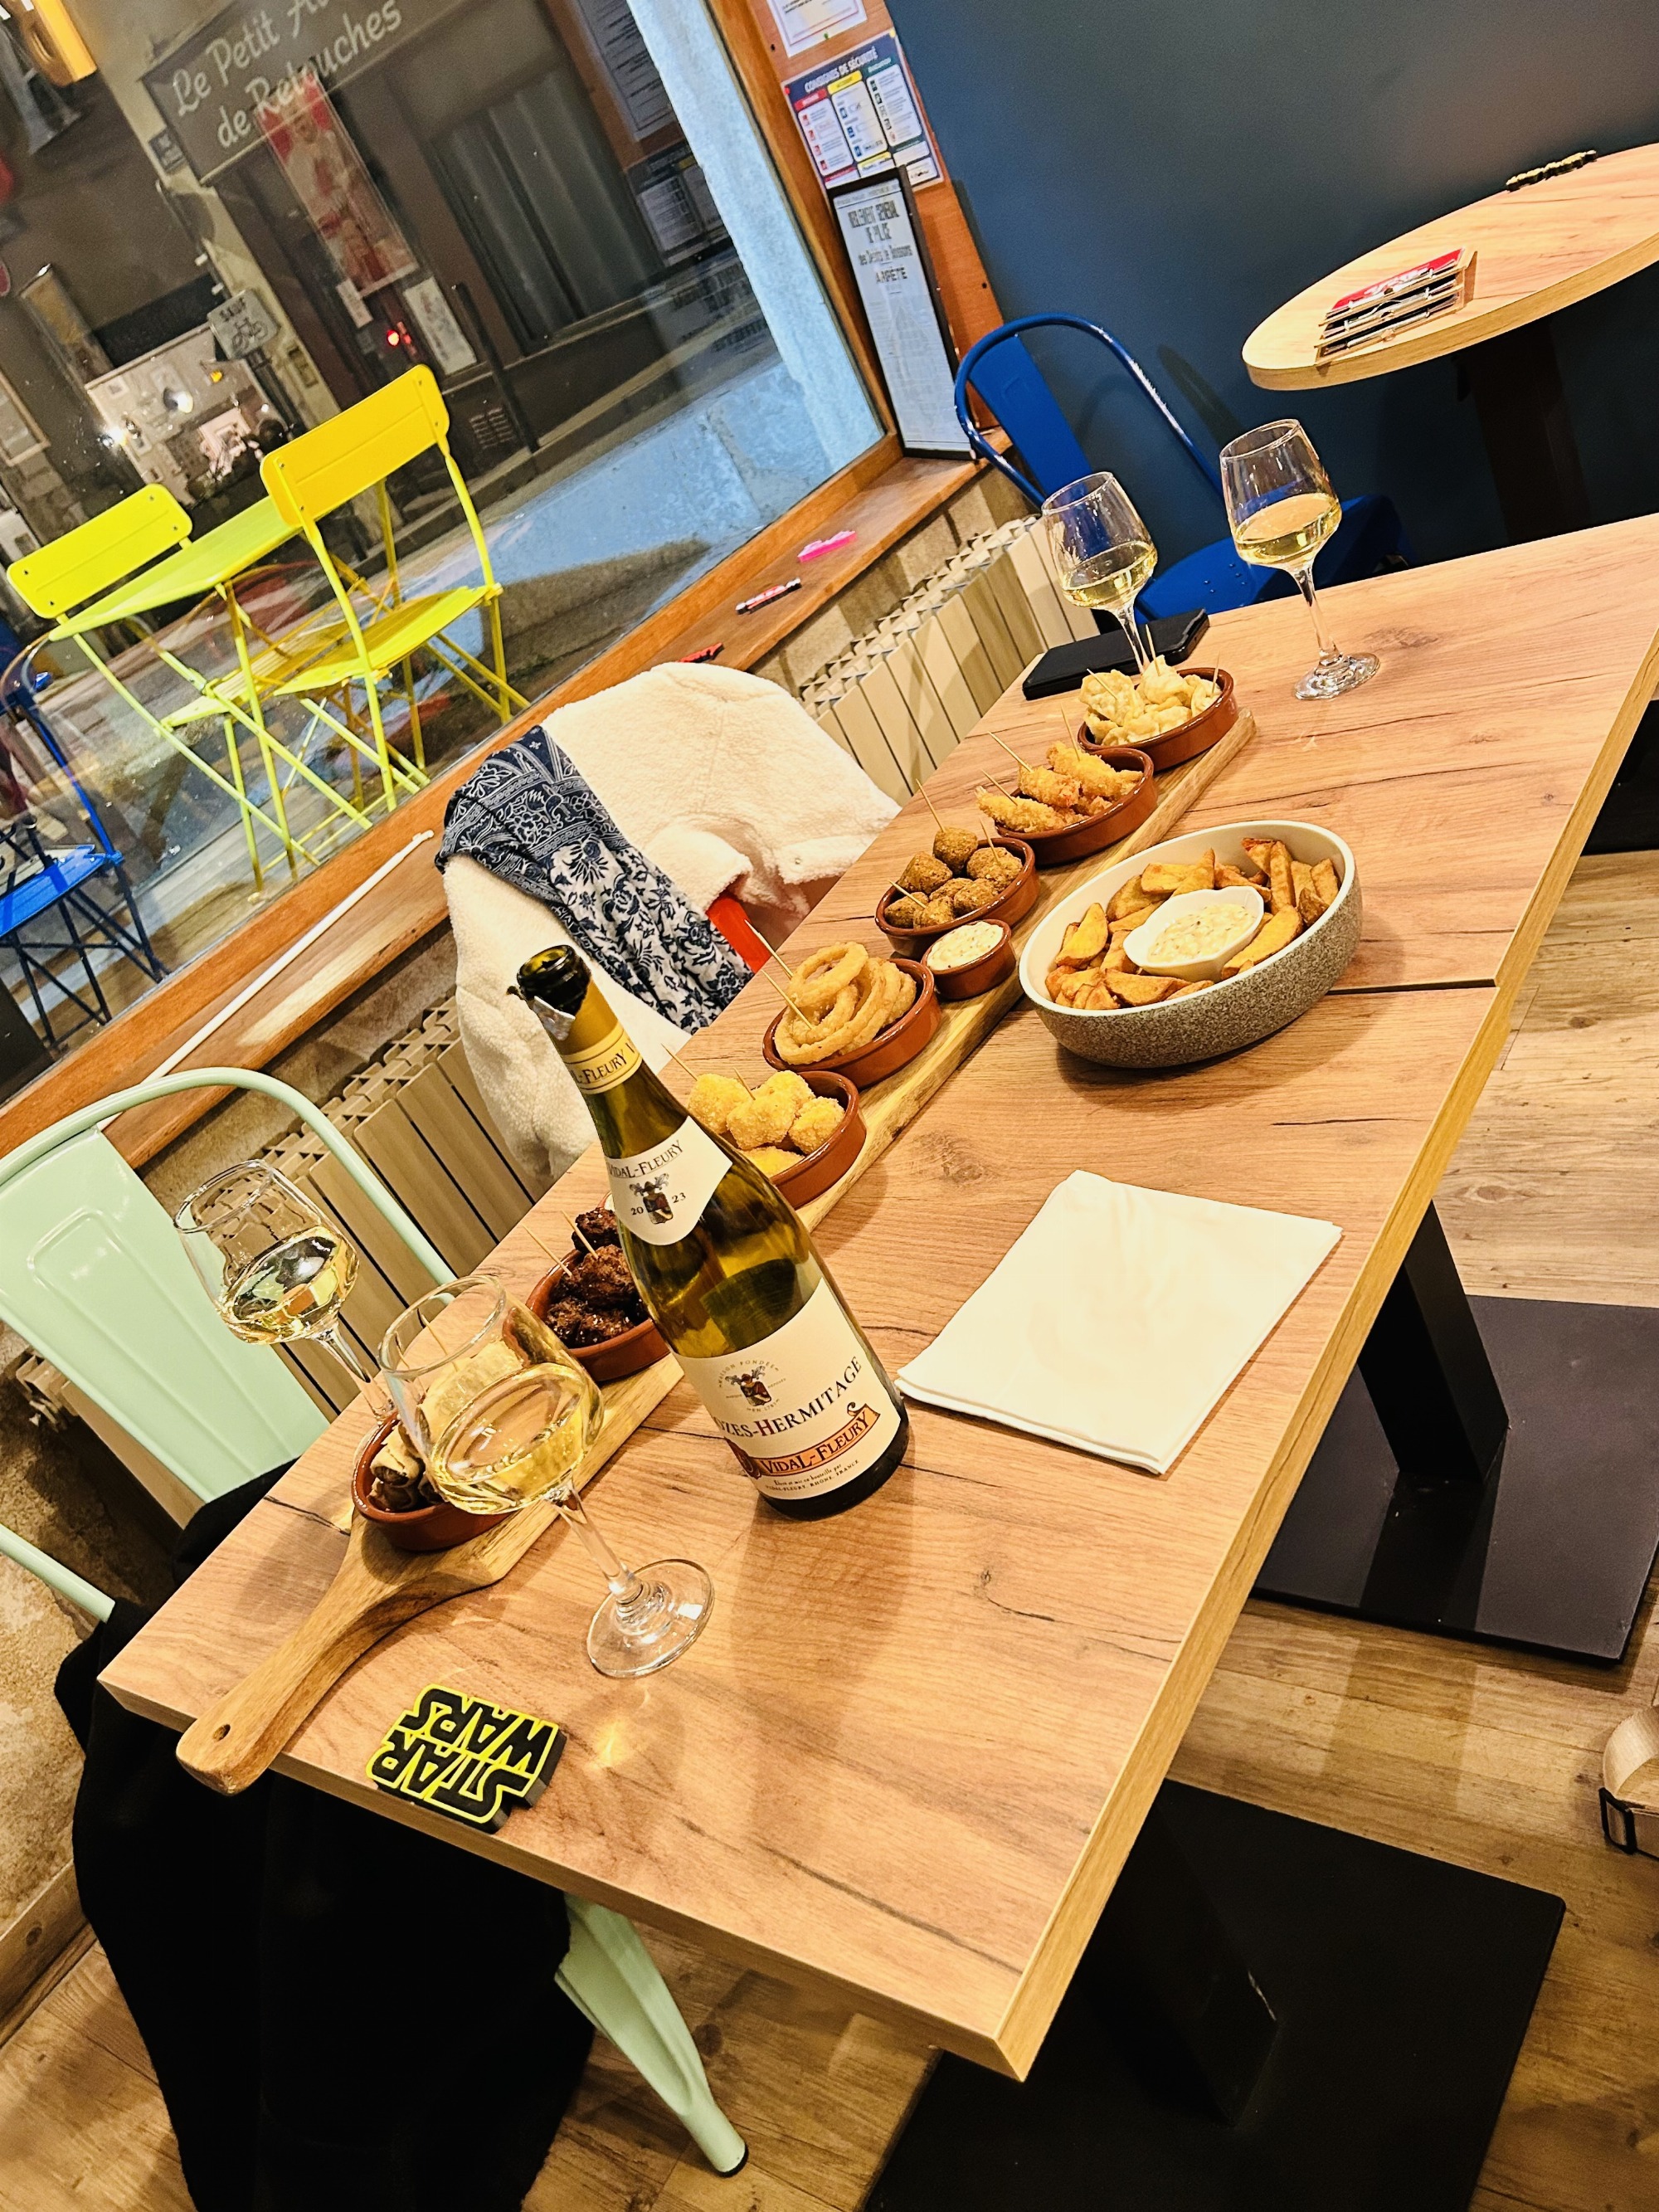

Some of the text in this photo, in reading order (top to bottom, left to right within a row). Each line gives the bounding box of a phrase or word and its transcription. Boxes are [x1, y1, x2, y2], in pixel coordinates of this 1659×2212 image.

[173, 68, 212, 117] Le
[206, 9, 280, 87] Petit
[217, 0, 402, 149] de Retouches
[608, 1139, 684, 1178] VIDAL-FLEURY
[630, 1206, 644, 1216] 20
[760, 1411, 869, 1474] VIDAL-FLEURY
[398, 1683, 559, 1775] WARS
[366, 1729, 533, 1824] STAR
